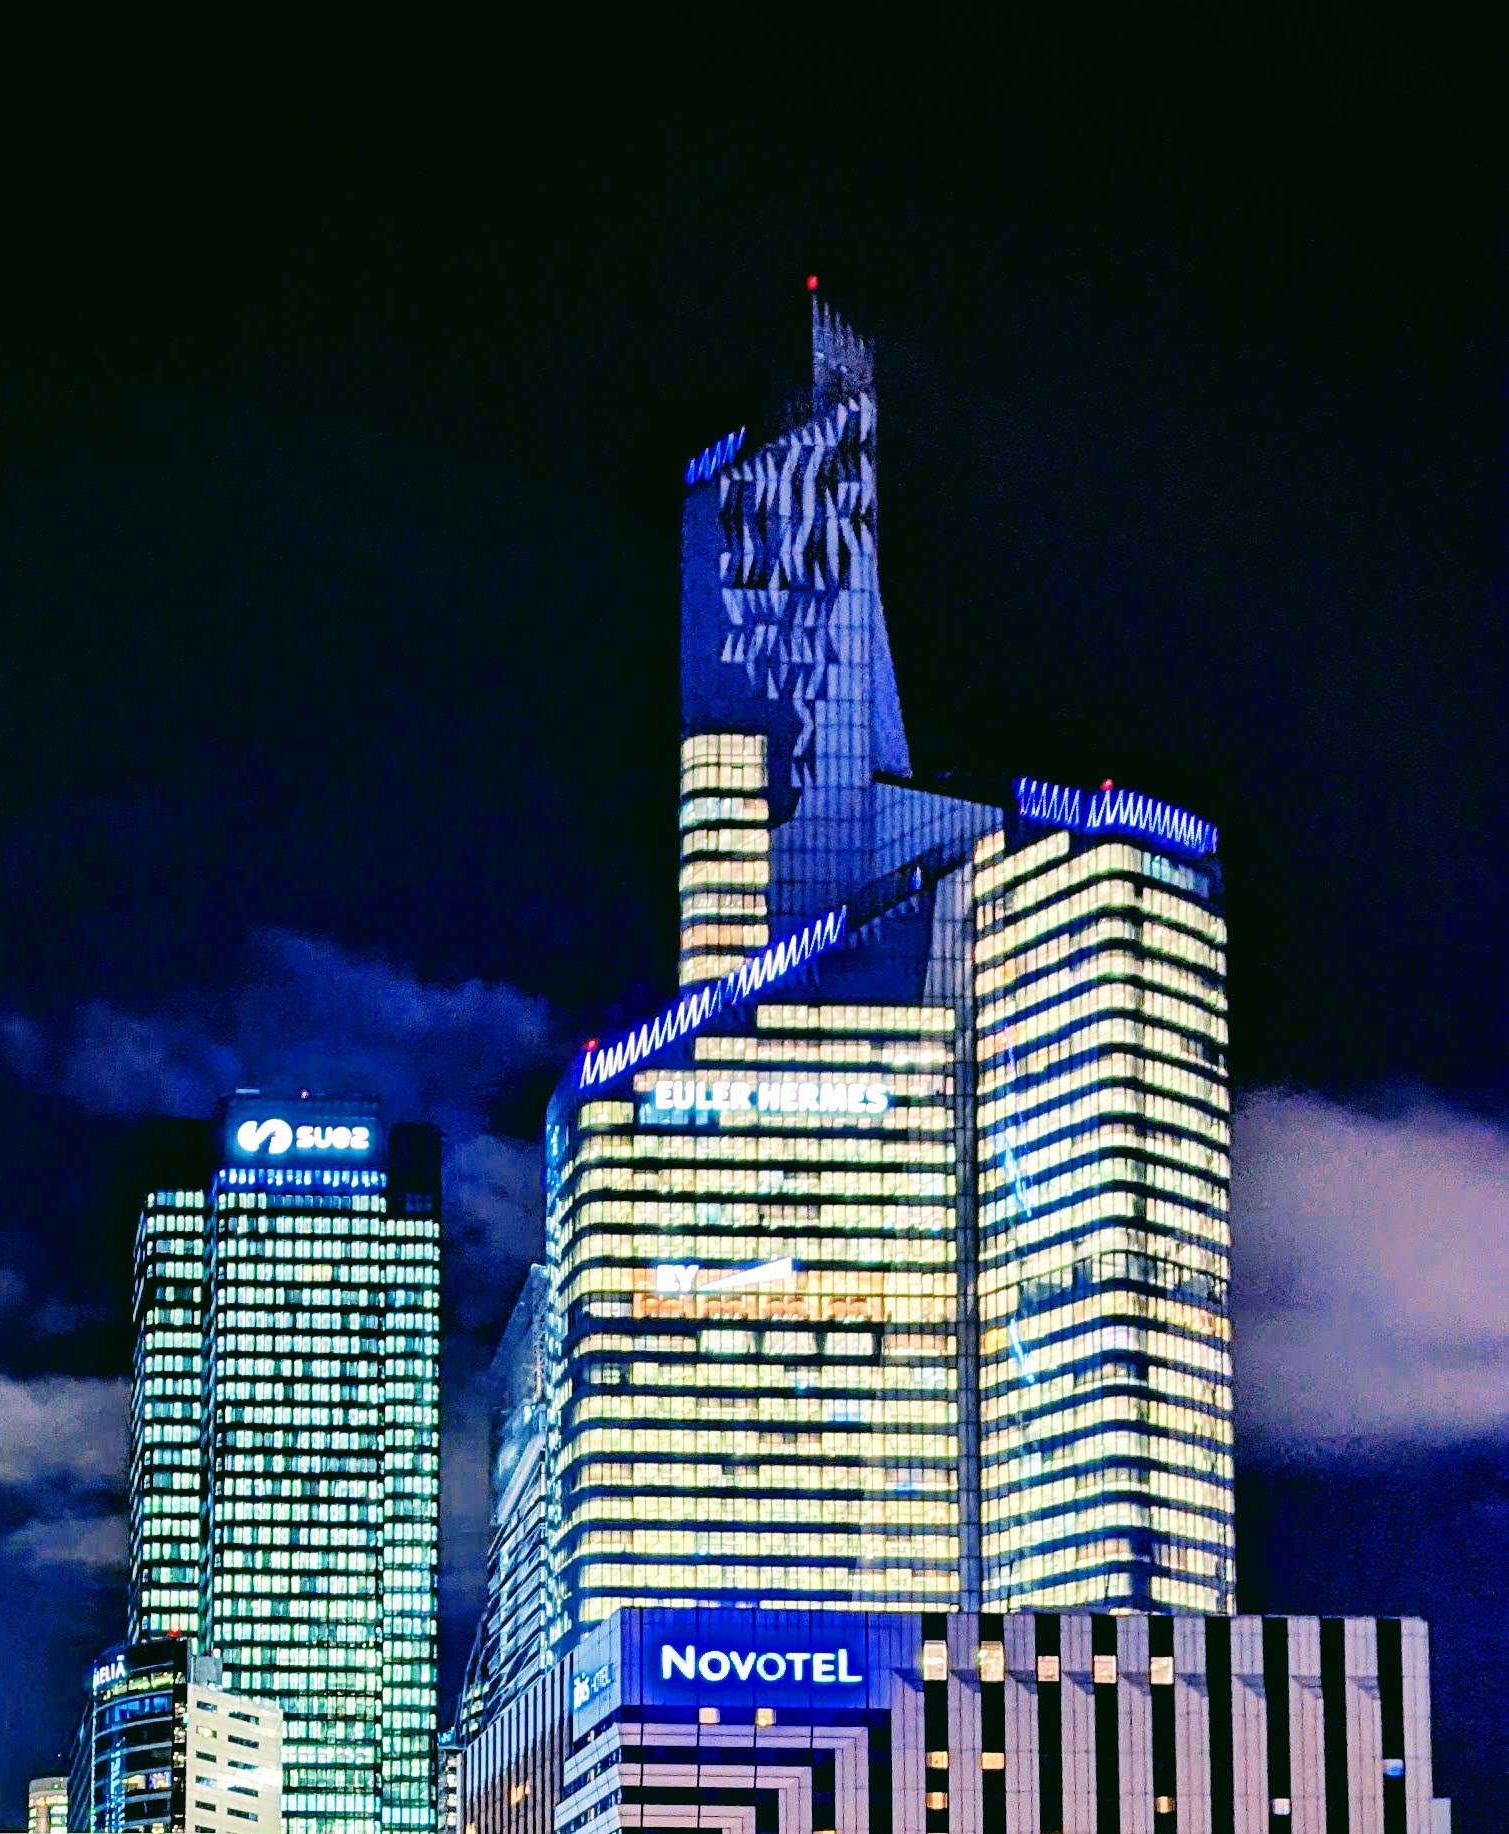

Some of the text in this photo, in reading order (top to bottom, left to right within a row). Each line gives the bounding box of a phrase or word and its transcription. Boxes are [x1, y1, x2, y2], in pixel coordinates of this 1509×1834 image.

[655, 1080, 889, 1113] EULER HERMES
[656, 1264, 699, 1292] EY
[661, 1645, 863, 1683] NOVOTEL
